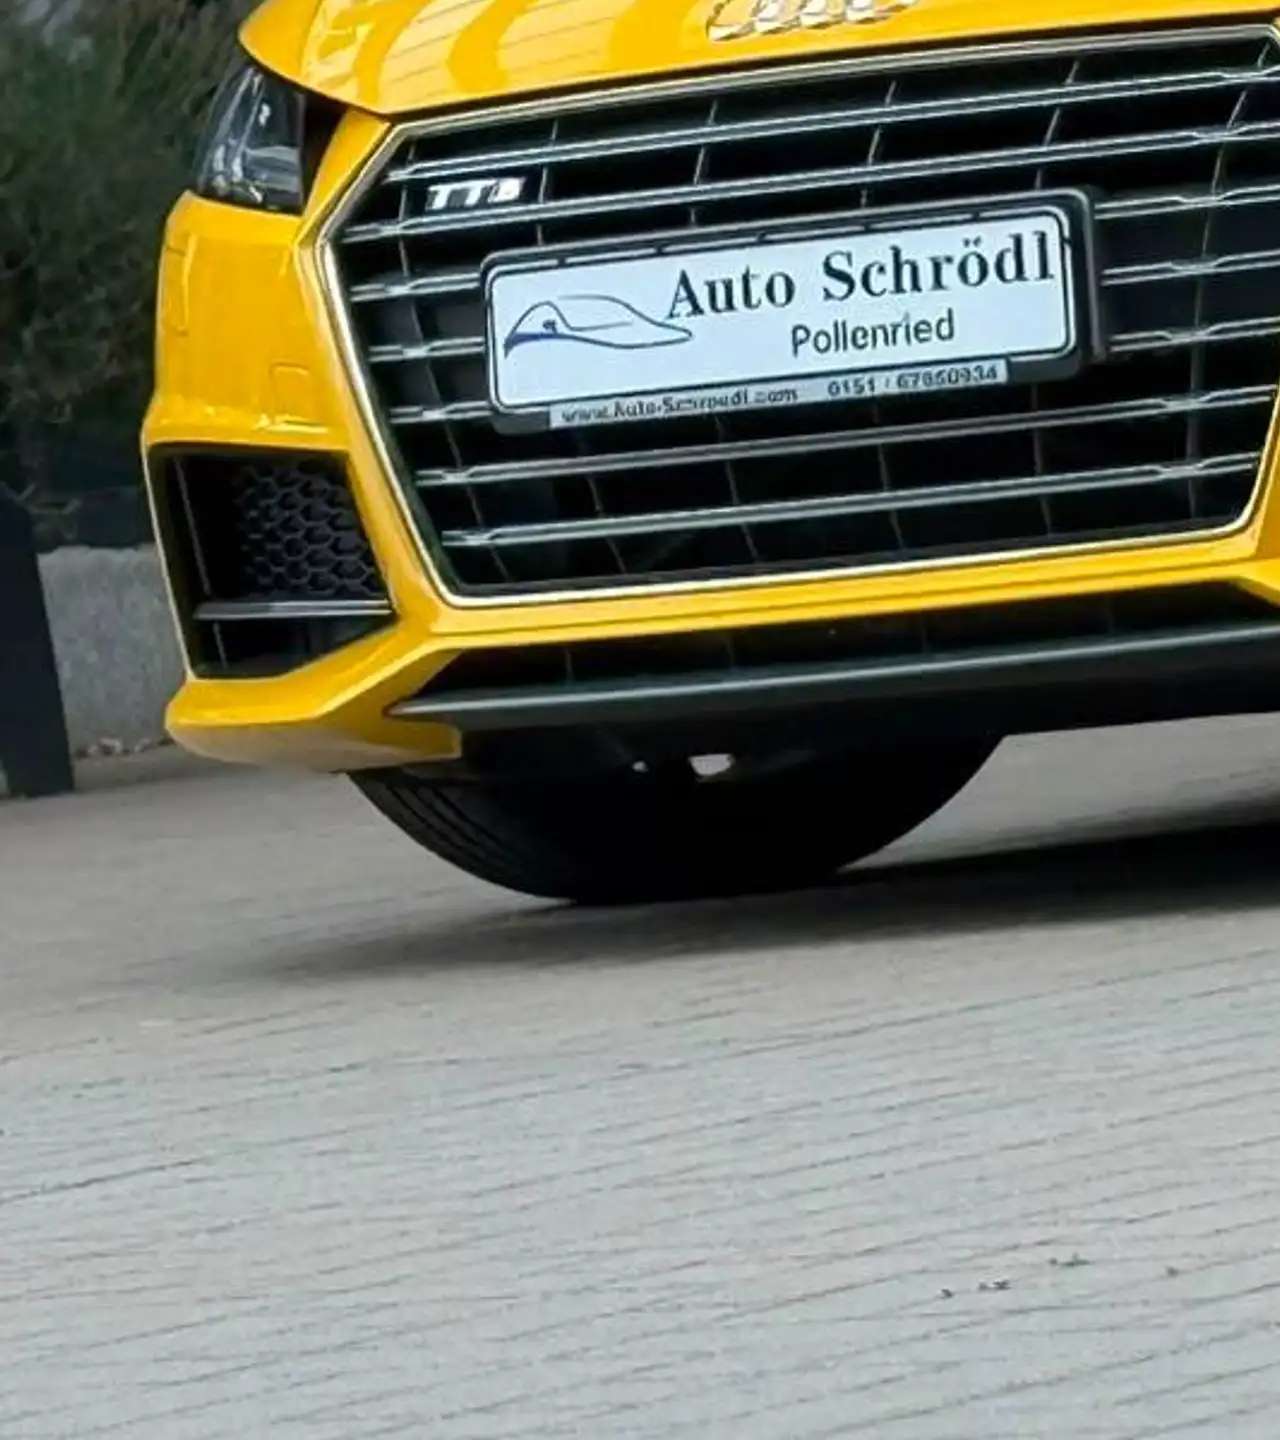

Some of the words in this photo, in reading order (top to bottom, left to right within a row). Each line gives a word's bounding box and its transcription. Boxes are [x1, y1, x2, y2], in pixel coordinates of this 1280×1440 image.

[667, 264, 796, 320] Auto
[822, 230, 1055, 302] Schrödl
[791, 309, 956, 358] Pollenried
